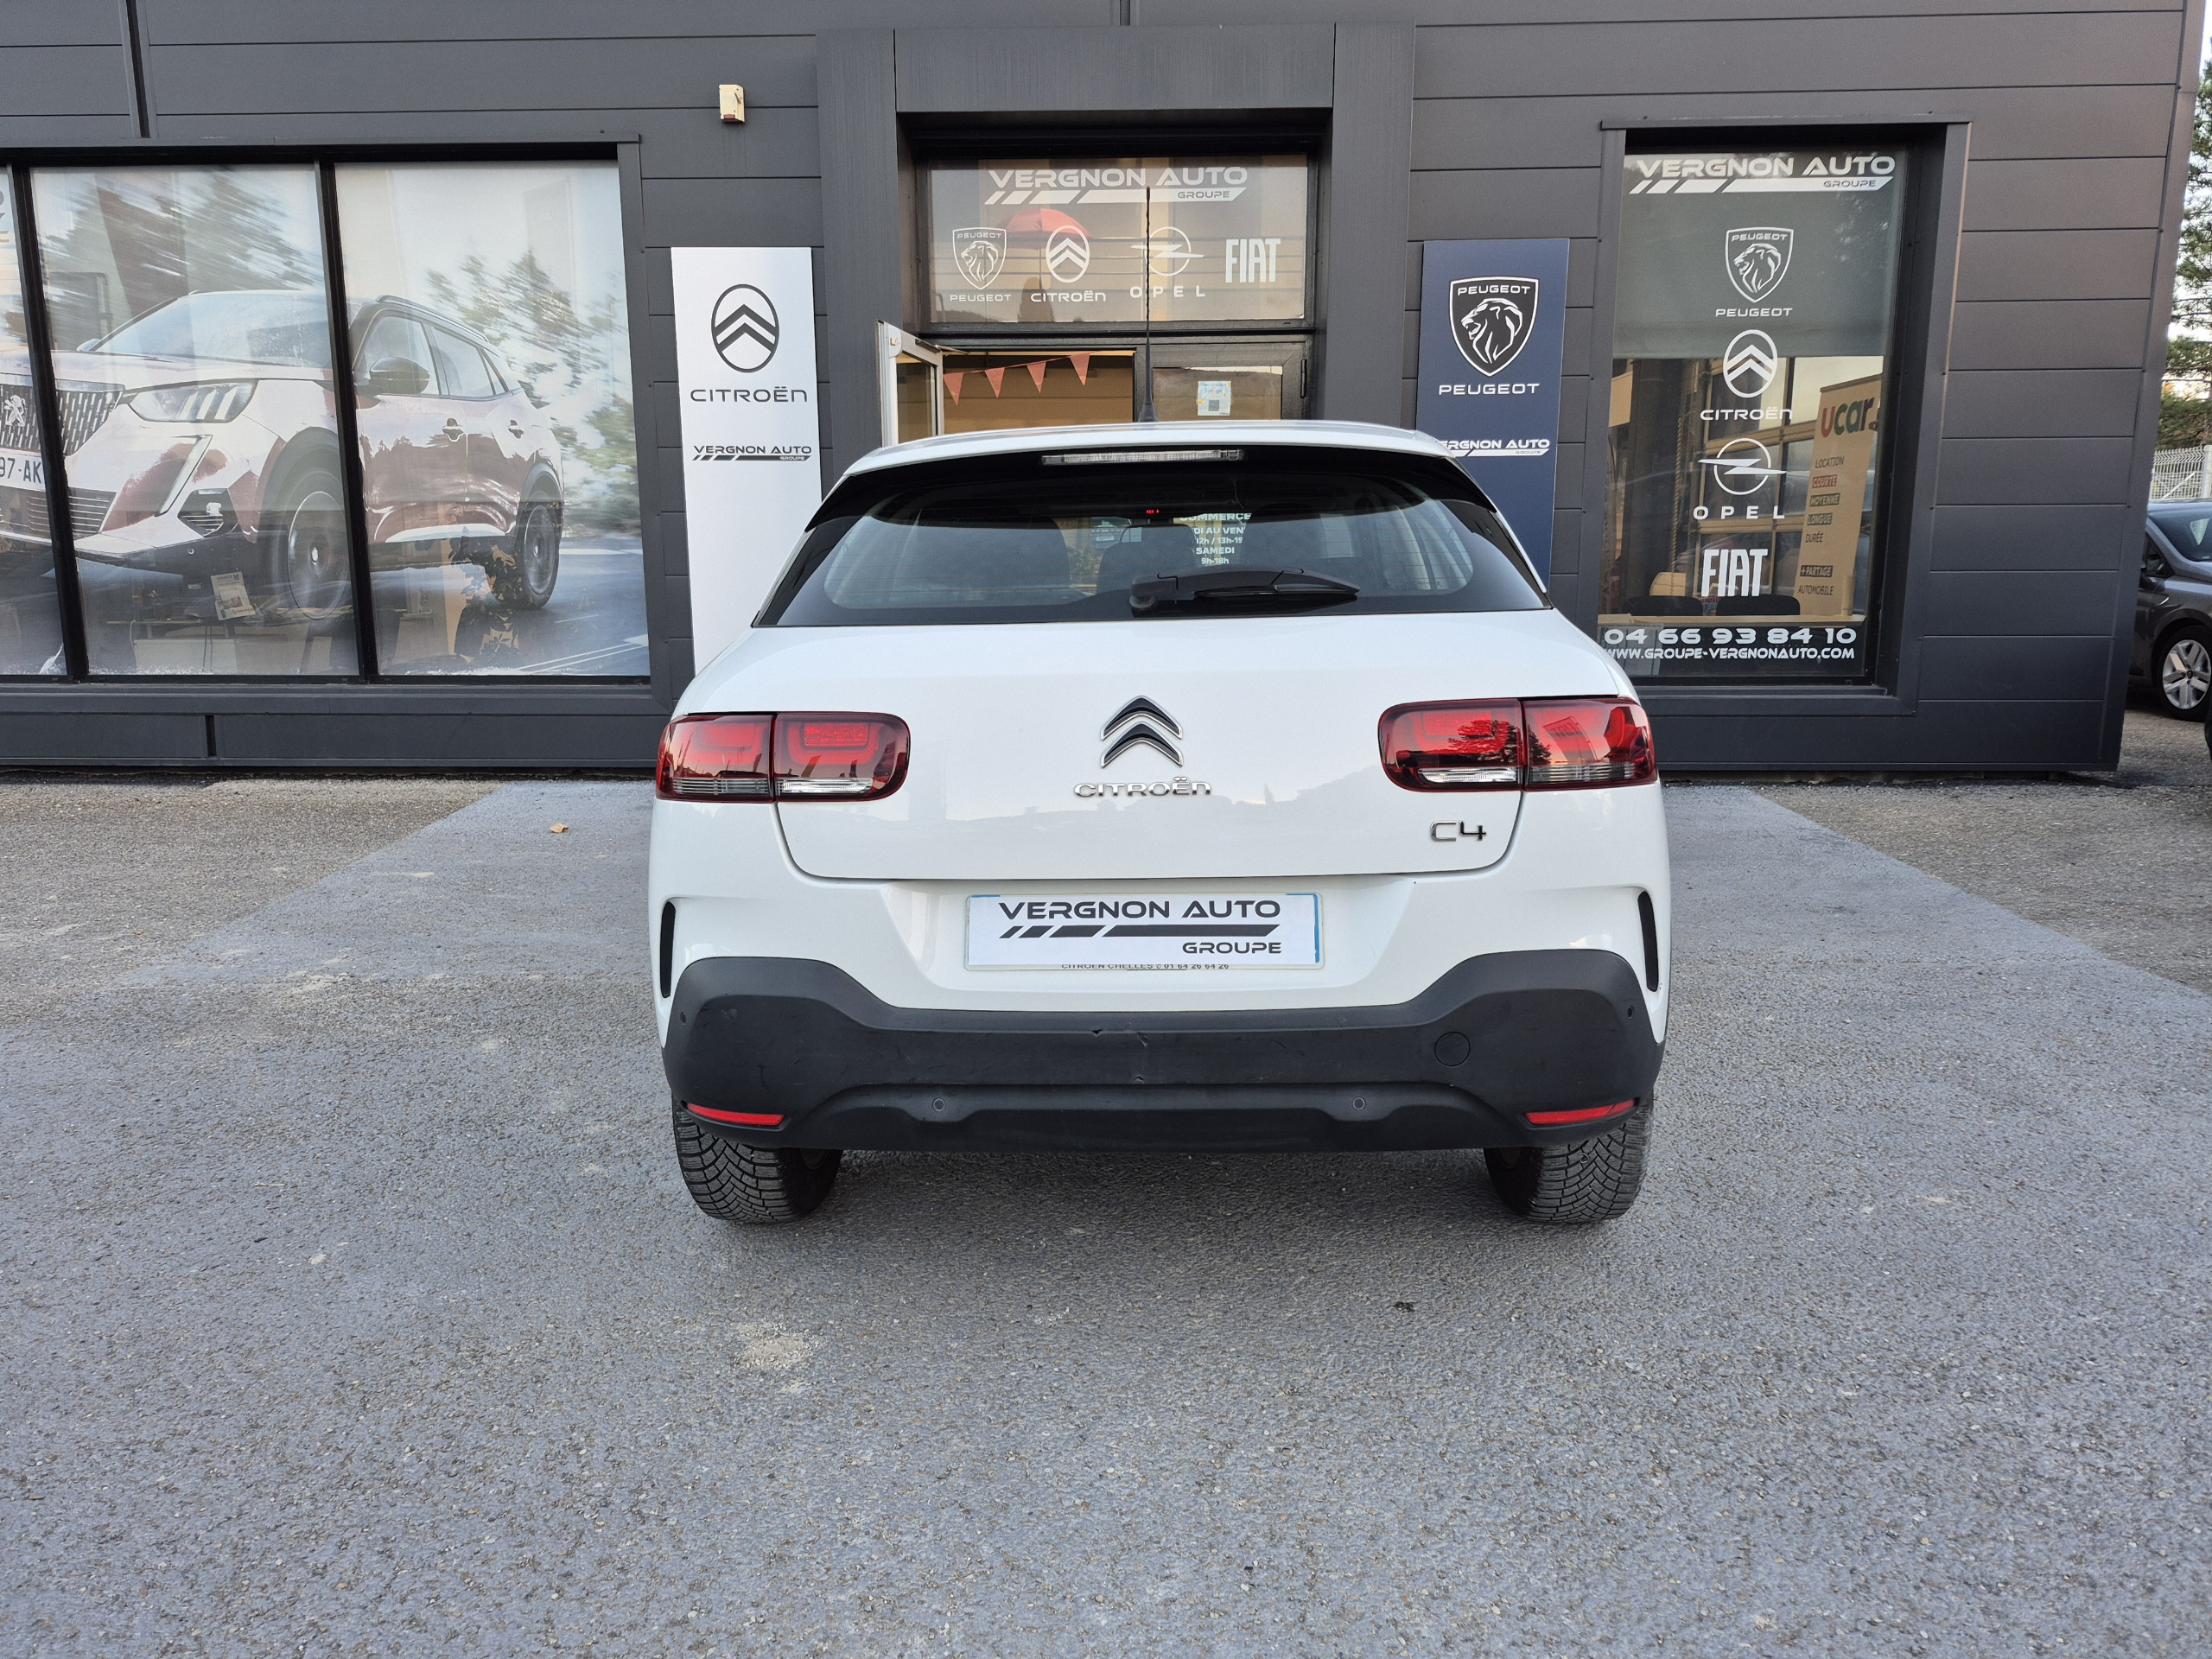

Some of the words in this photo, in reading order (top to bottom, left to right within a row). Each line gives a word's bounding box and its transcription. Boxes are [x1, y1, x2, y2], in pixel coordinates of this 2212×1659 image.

[1637, 157, 1795, 178] VERGNON
[1802, 156, 1896, 175] AUTO
[988, 168, 1147, 188] VERGNON
[1155, 166, 1248, 186] AUTO
[1823, 180, 1877, 188] GROUPE
[1177, 190, 1230, 200] GROUPE
[1731, 232, 1789, 242] PEUGEOT
[1225, 238, 1281, 283] FIAT
[1458, 285, 1530, 296] PEUGEOT
[1715, 308, 1793, 317] PEUGEOT
[1439, 383, 1540, 395] PEUGEOT
[693, 445, 766, 454] VERGNON
[771, 445, 812, 454] AUTO
[1439, 440, 1502, 449] ERGNON
[1505, 439, 1550, 448] AUTO
[1815, 456, 1845, 468] LOCATION
[1813, 475, 1837, 487] COURTE
[1810, 493, 1840, 506] MOYENNE
[1693, 505, 1785, 520] OPEL
[1808, 514, 1832, 524] LONGUE
[1805, 531, 1823, 543] DURÉE
[1700, 549, 1768, 597] FIAT
[1798, 585, 1834, 595] AUTOMOBILE
[1604, 628, 1648, 645] 04
[1658, 628, 1701, 645] 66
[1712, 628, 1757, 645] 93
[1767, 628, 1814, 645] 84
[1825, 627, 1857, 644] 10
[1430, 820, 1487, 842] C4
[999, 900, 1171, 920] VERGNON
[1181, 899, 1281, 918] AUTO
[1182, 942, 1281, 954] GROUPE
